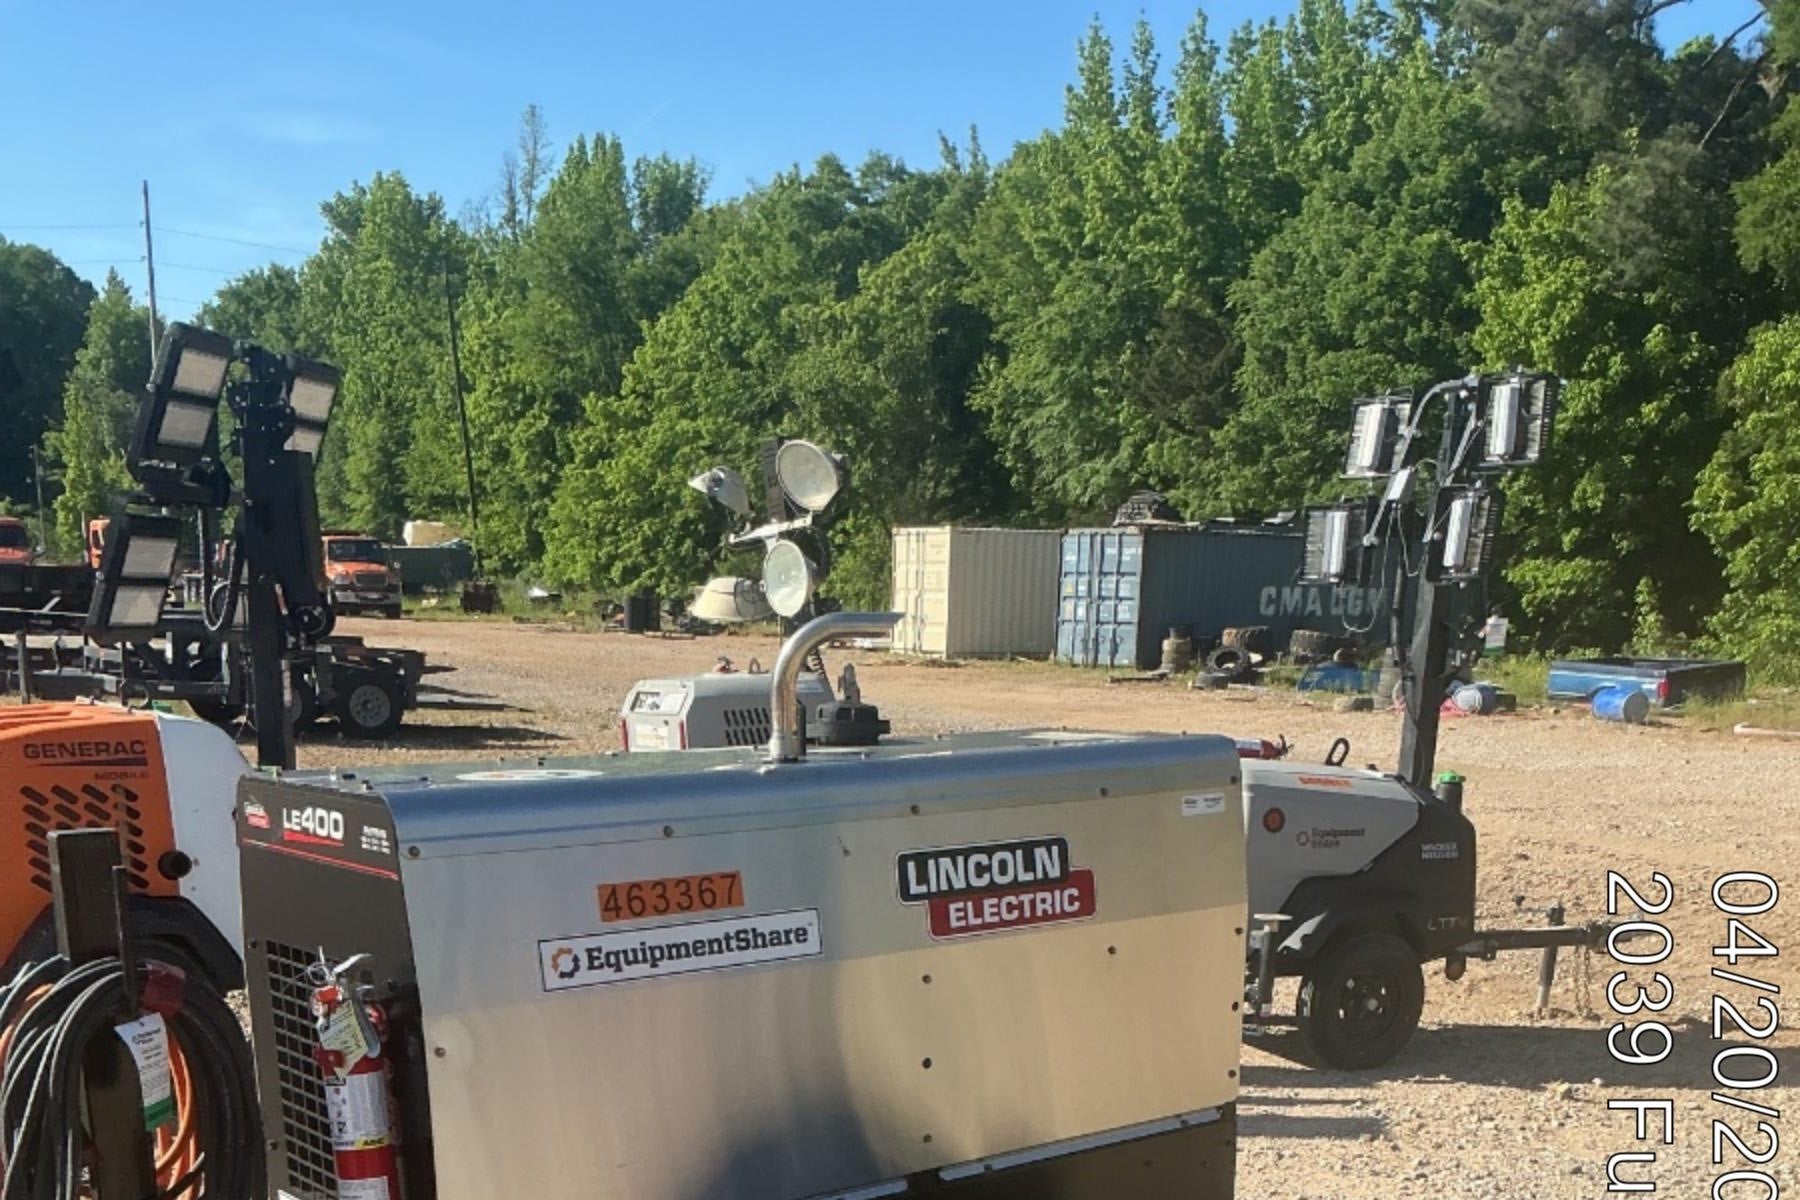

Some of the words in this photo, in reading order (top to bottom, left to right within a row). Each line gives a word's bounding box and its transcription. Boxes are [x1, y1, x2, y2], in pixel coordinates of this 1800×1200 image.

[1259, 586, 1322, 617] CMA
[23, 740, 146, 759] GENERAC
[283, 806, 345, 840] LE400
[907, 845, 1061, 895] LINCOLN
[602, 873, 737, 919] 463367
[949, 887, 1080, 929] ELECTRIC
[585, 925, 809, 972] EquipmentShare
